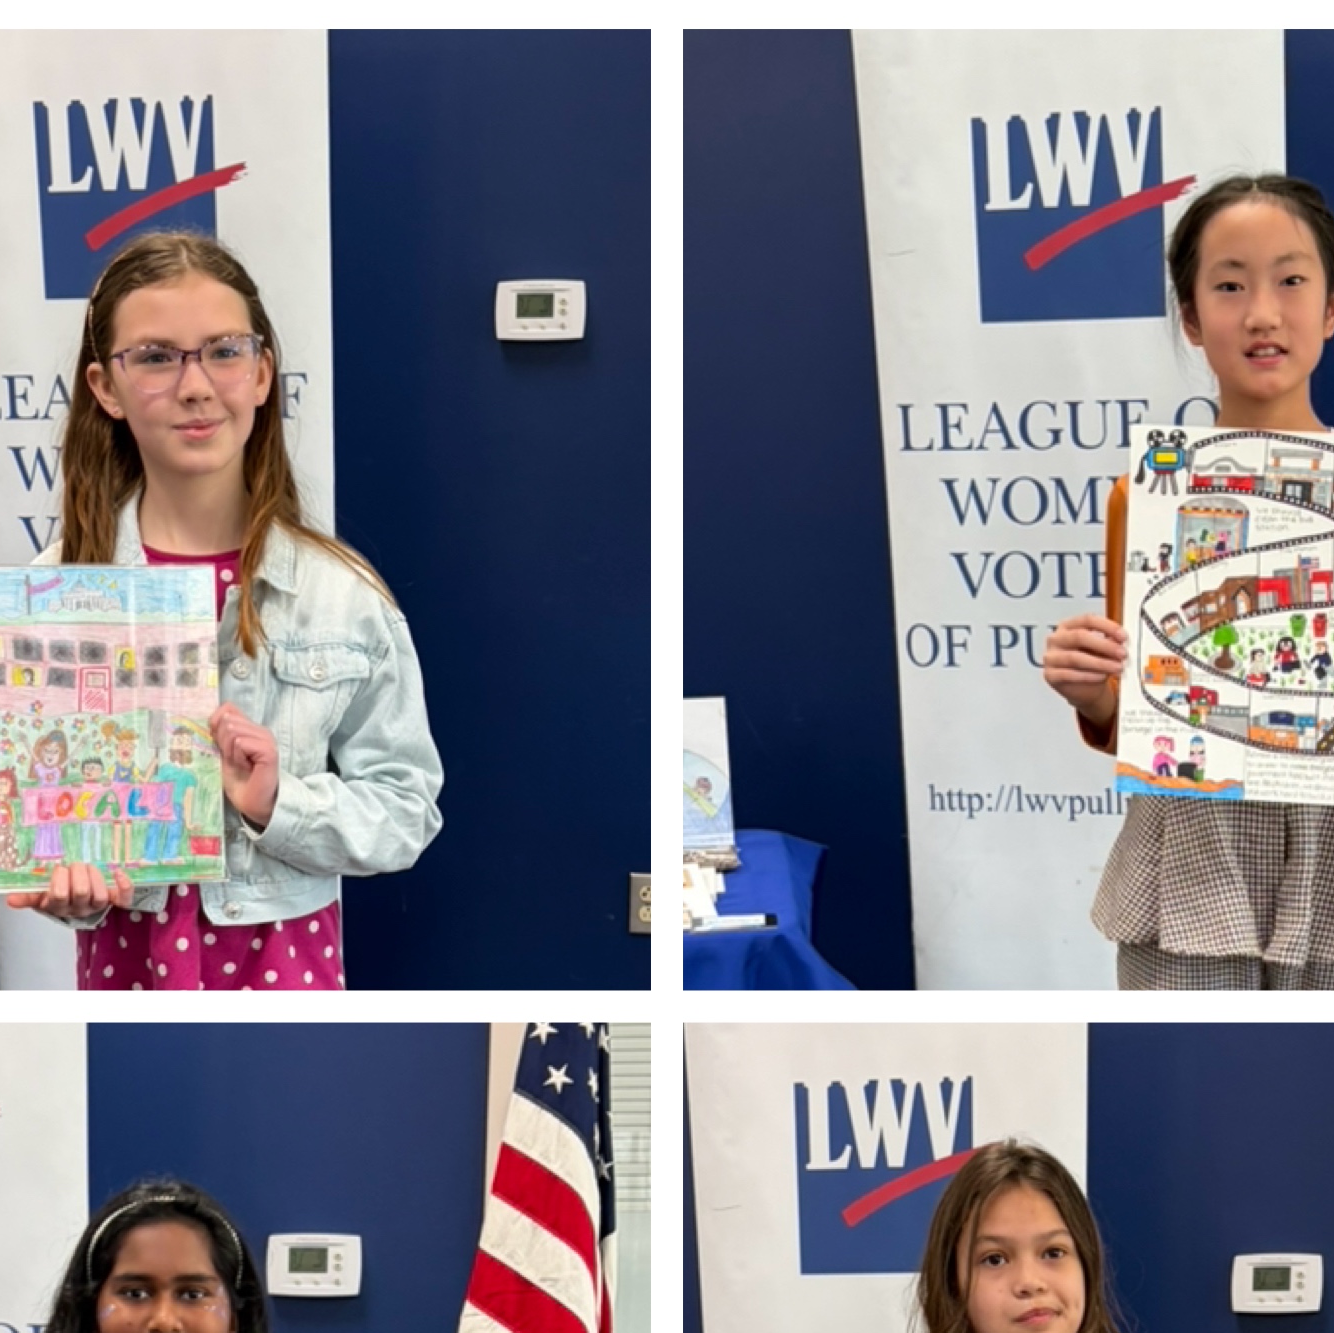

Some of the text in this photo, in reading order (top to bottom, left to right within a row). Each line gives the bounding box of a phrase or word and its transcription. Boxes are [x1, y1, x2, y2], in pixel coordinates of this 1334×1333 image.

[47, 95, 212, 193] LWV
[983, 106, 1164, 211] LWV
[279, 372, 308, 419] F
[940, 476, 1117, 526] WOM
[905, 622, 972, 668] OF
[928, 784, 1126, 820] http://lwvpull
[806, 1076, 972, 1170] LWV
